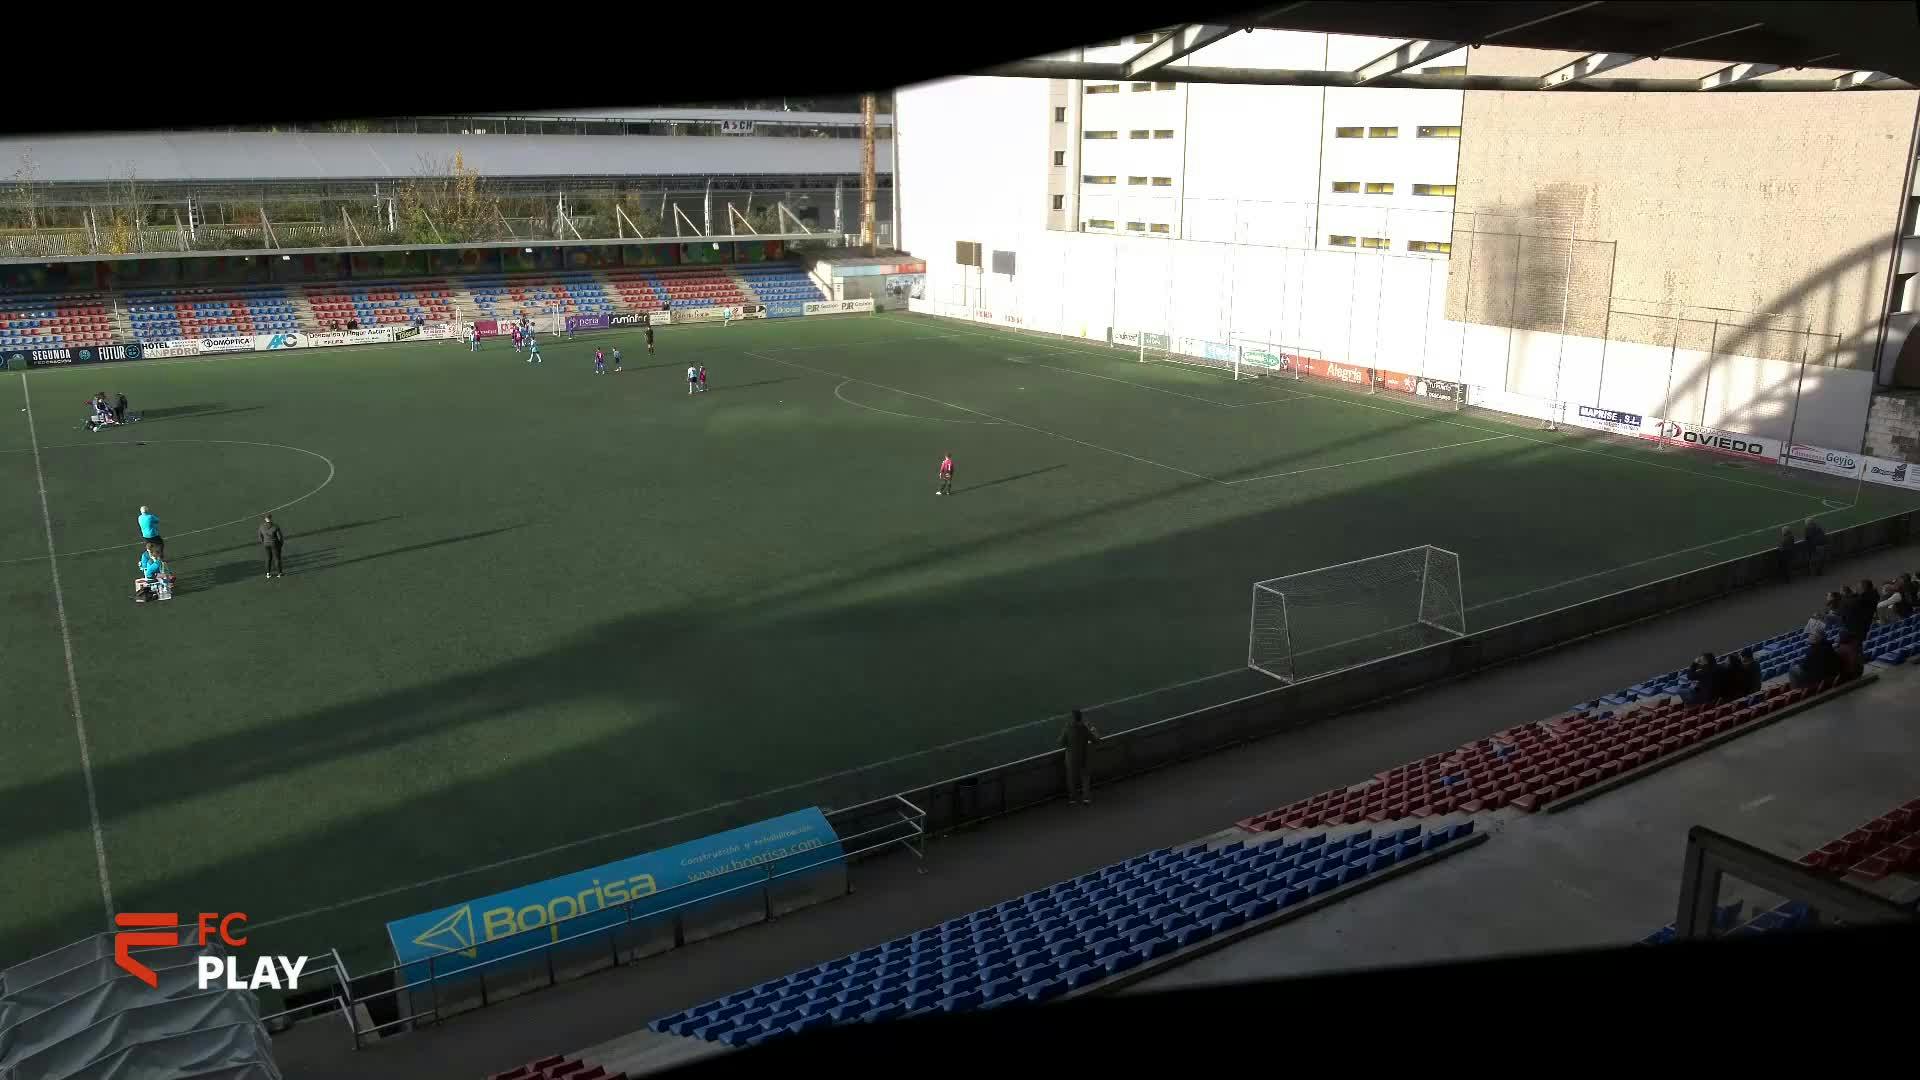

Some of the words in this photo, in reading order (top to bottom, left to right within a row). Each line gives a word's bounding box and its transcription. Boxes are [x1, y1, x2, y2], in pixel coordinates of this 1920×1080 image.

[32, 348, 71, 361] SEGUNDA
[141, 341, 170, 350] HOTEL
[1683, 431, 1763, 455] OVIEDO
[483, 872, 657, 943] Boprisa
